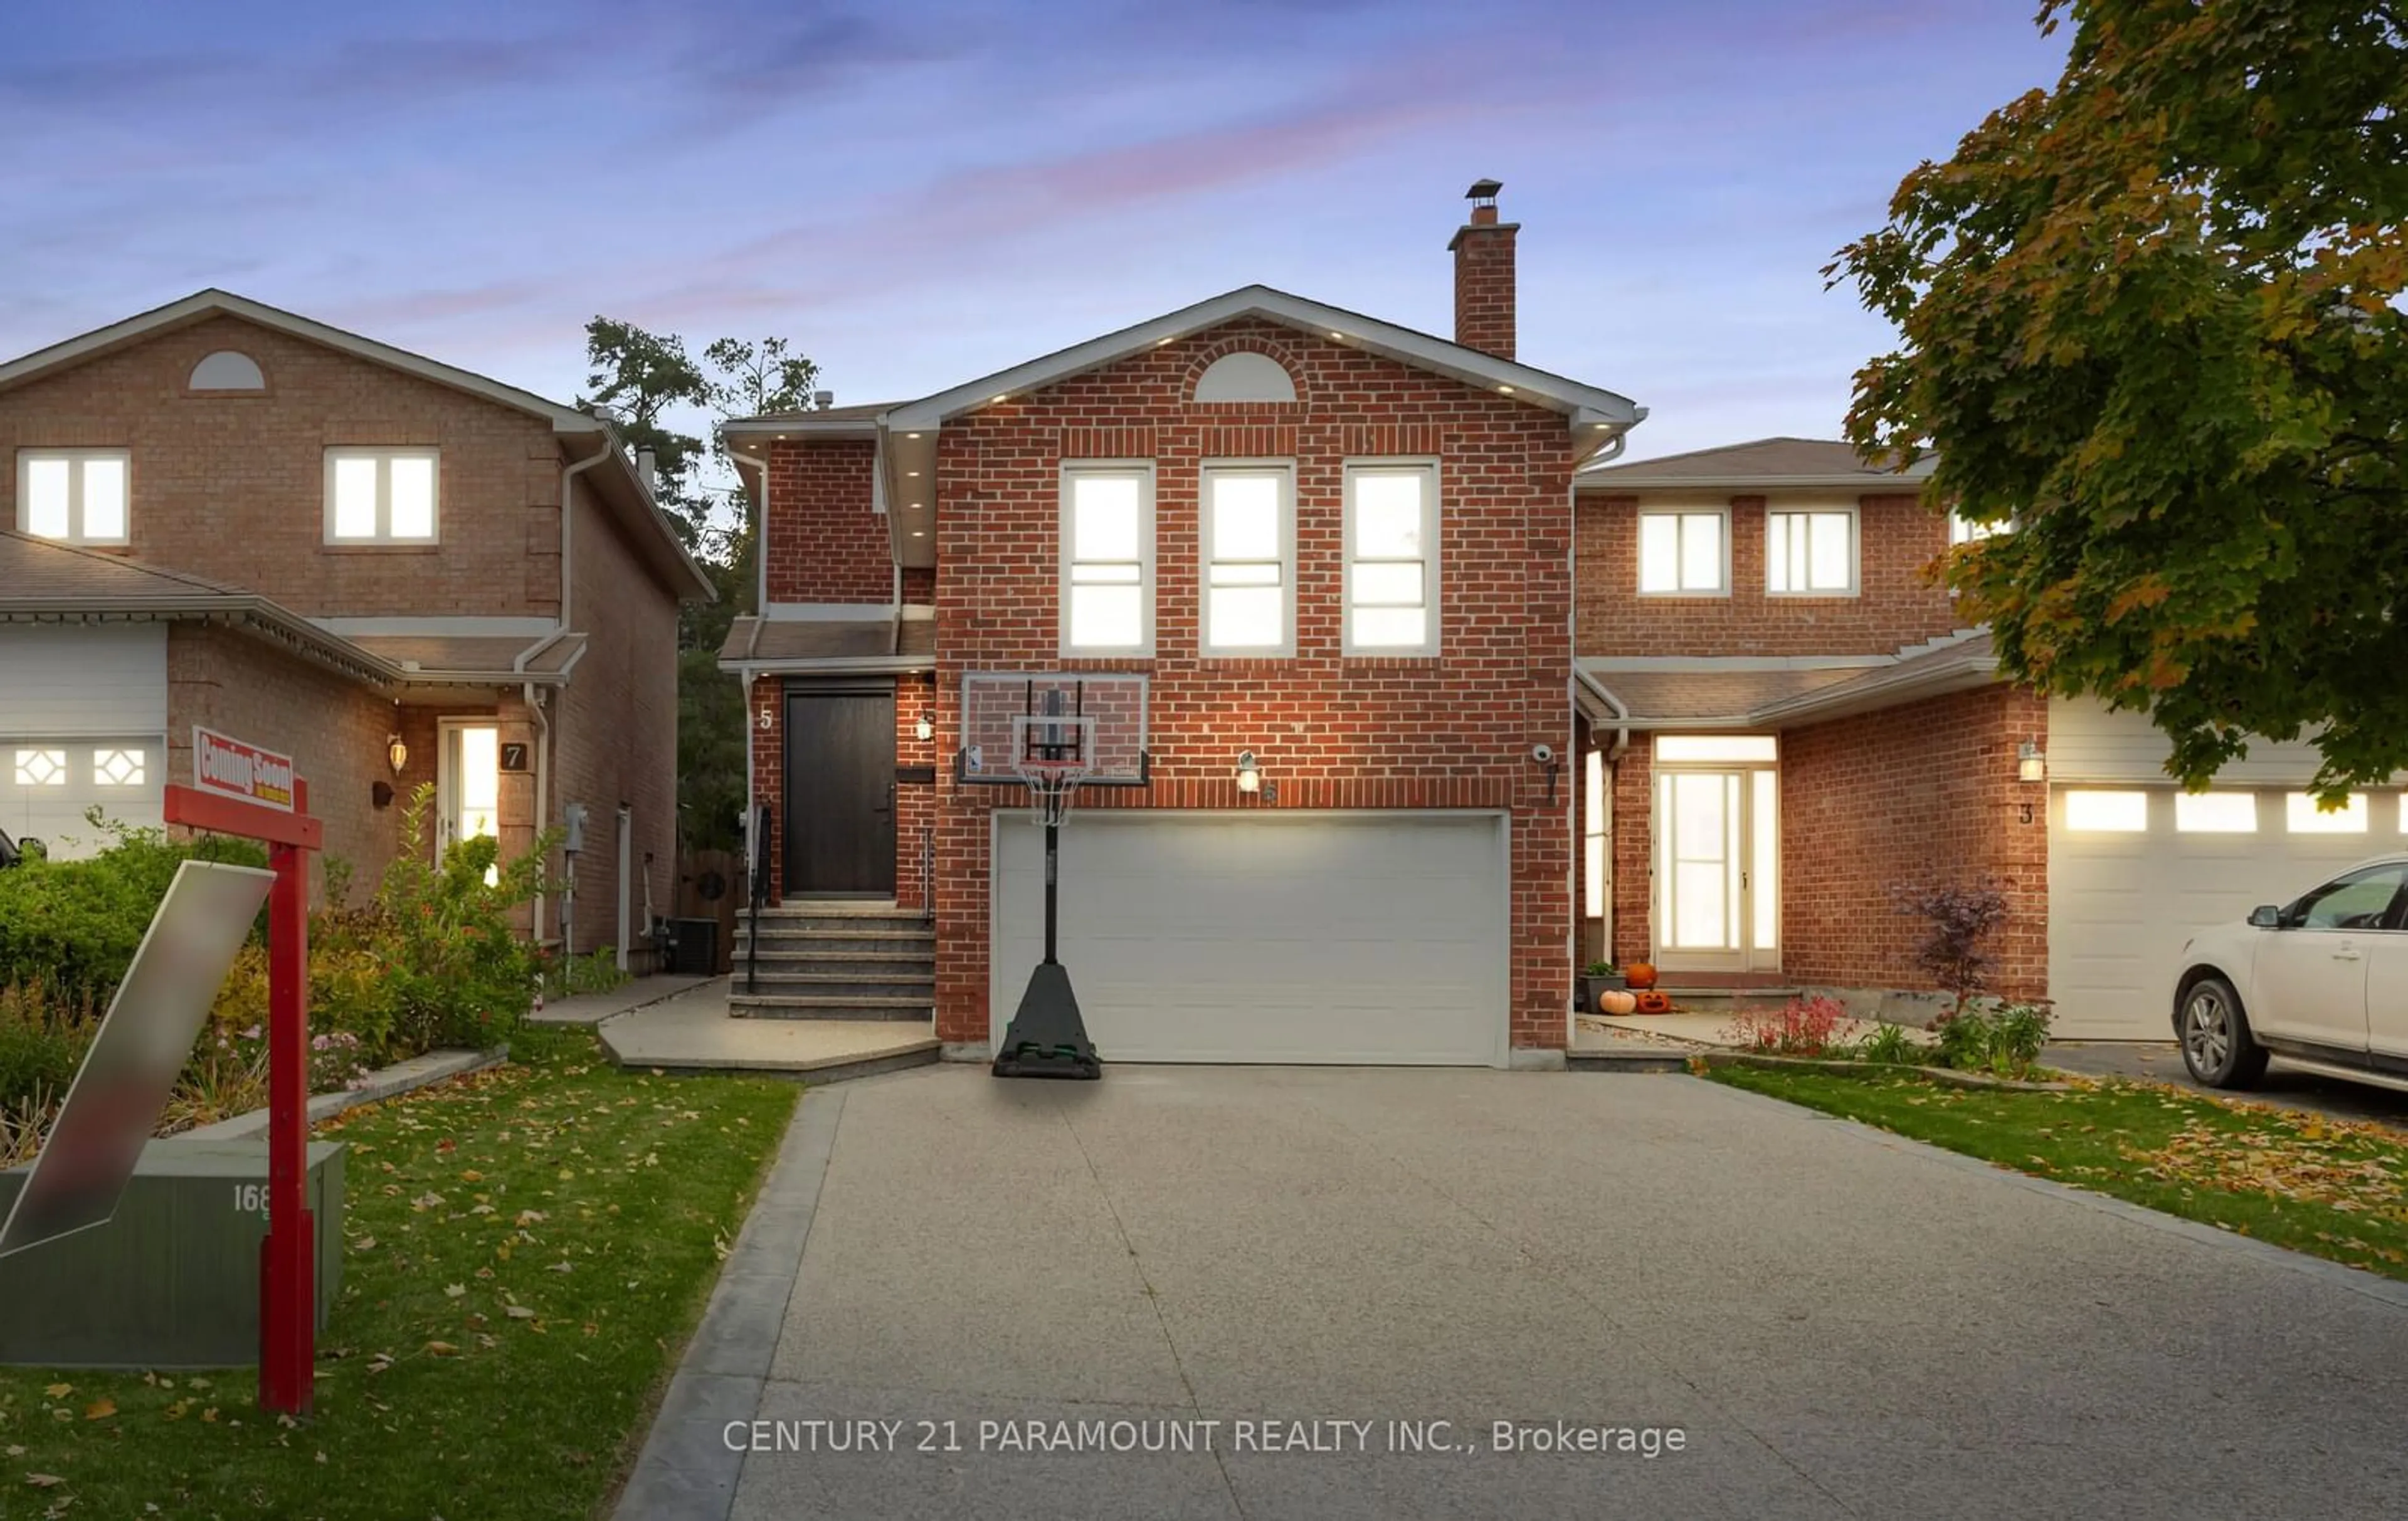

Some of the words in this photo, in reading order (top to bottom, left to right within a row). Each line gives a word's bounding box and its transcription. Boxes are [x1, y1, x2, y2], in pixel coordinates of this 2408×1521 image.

[760, 710, 772, 729] 5
[201, 734, 253, 795] Coming
[253, 752, 290, 791] Soon
[507, 746, 521, 767] 7
[2019, 803, 2033, 824] 3
